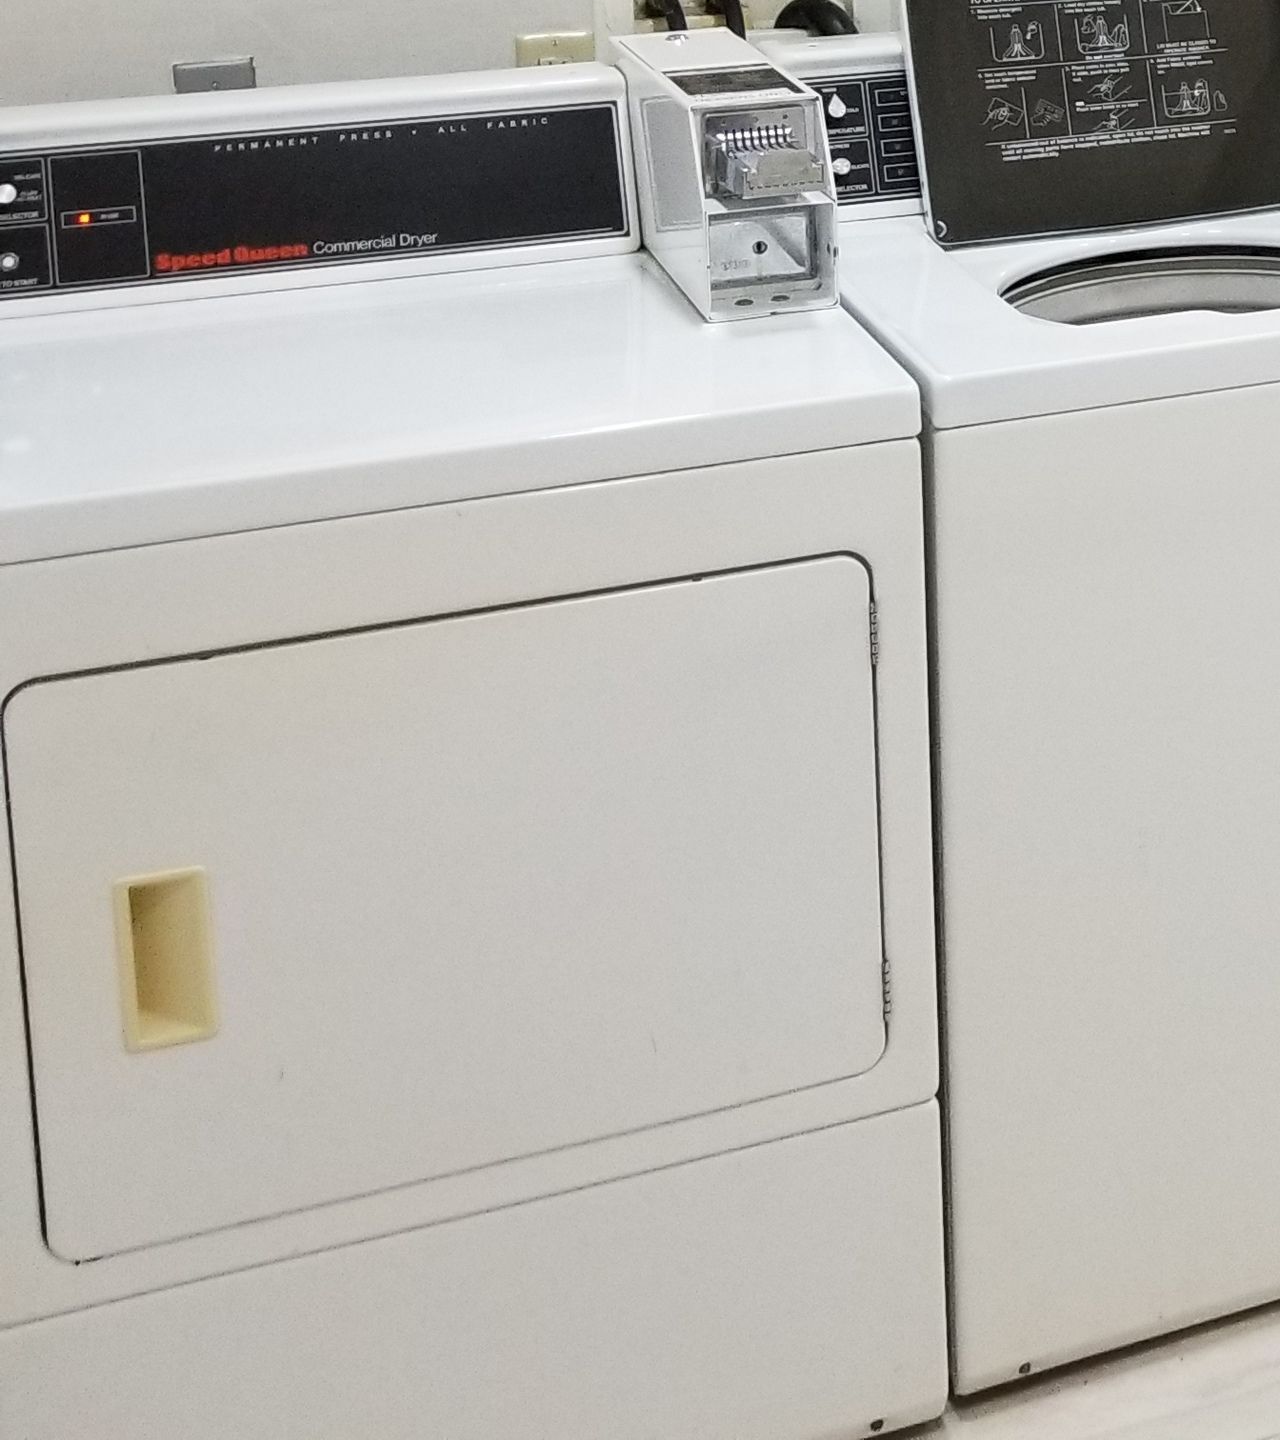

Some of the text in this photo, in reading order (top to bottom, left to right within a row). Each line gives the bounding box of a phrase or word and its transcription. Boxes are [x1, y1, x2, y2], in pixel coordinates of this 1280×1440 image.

[214, 117, 548, 152] PERMANENT PRESS ALL FABRIC
[155, 232, 438, 271] Speed Queen Commercial Dryer
